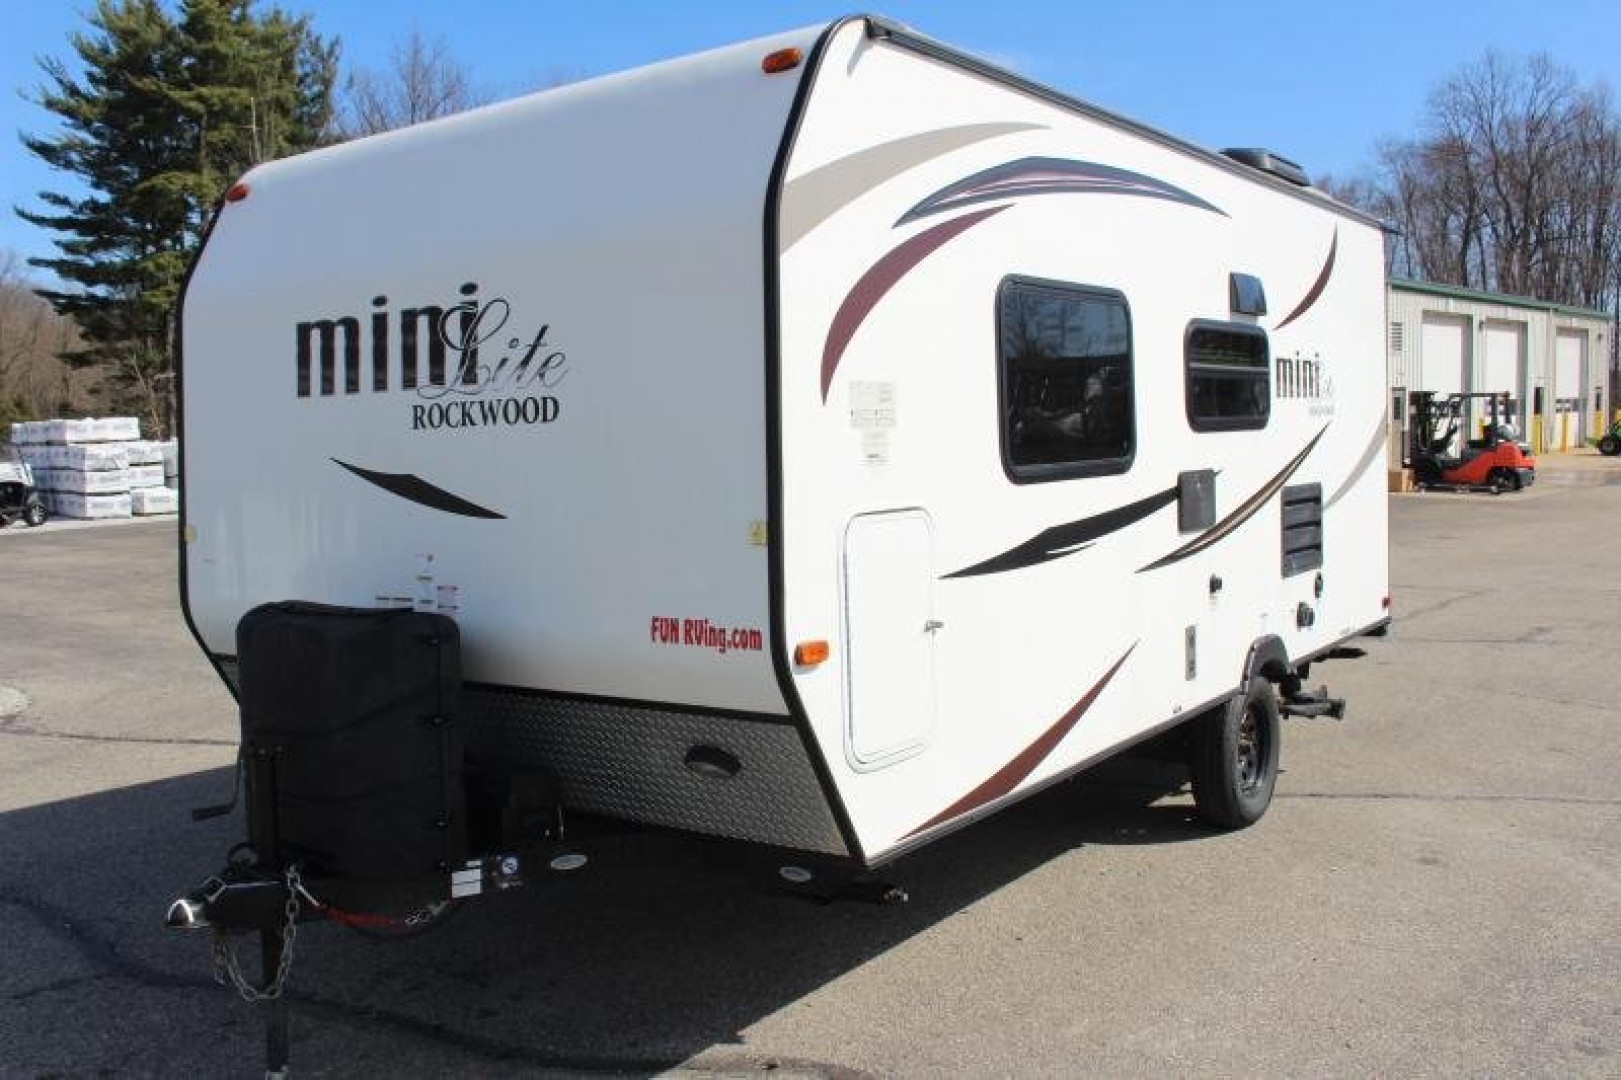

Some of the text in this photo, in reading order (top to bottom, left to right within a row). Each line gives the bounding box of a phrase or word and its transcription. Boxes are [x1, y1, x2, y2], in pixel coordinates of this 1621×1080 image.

[297, 281, 479, 399] mini
[1276, 350, 1320, 398] mini
[411, 396, 560, 430] ROCKWOOD
[651, 616, 763, 653] FUN RVing.com
